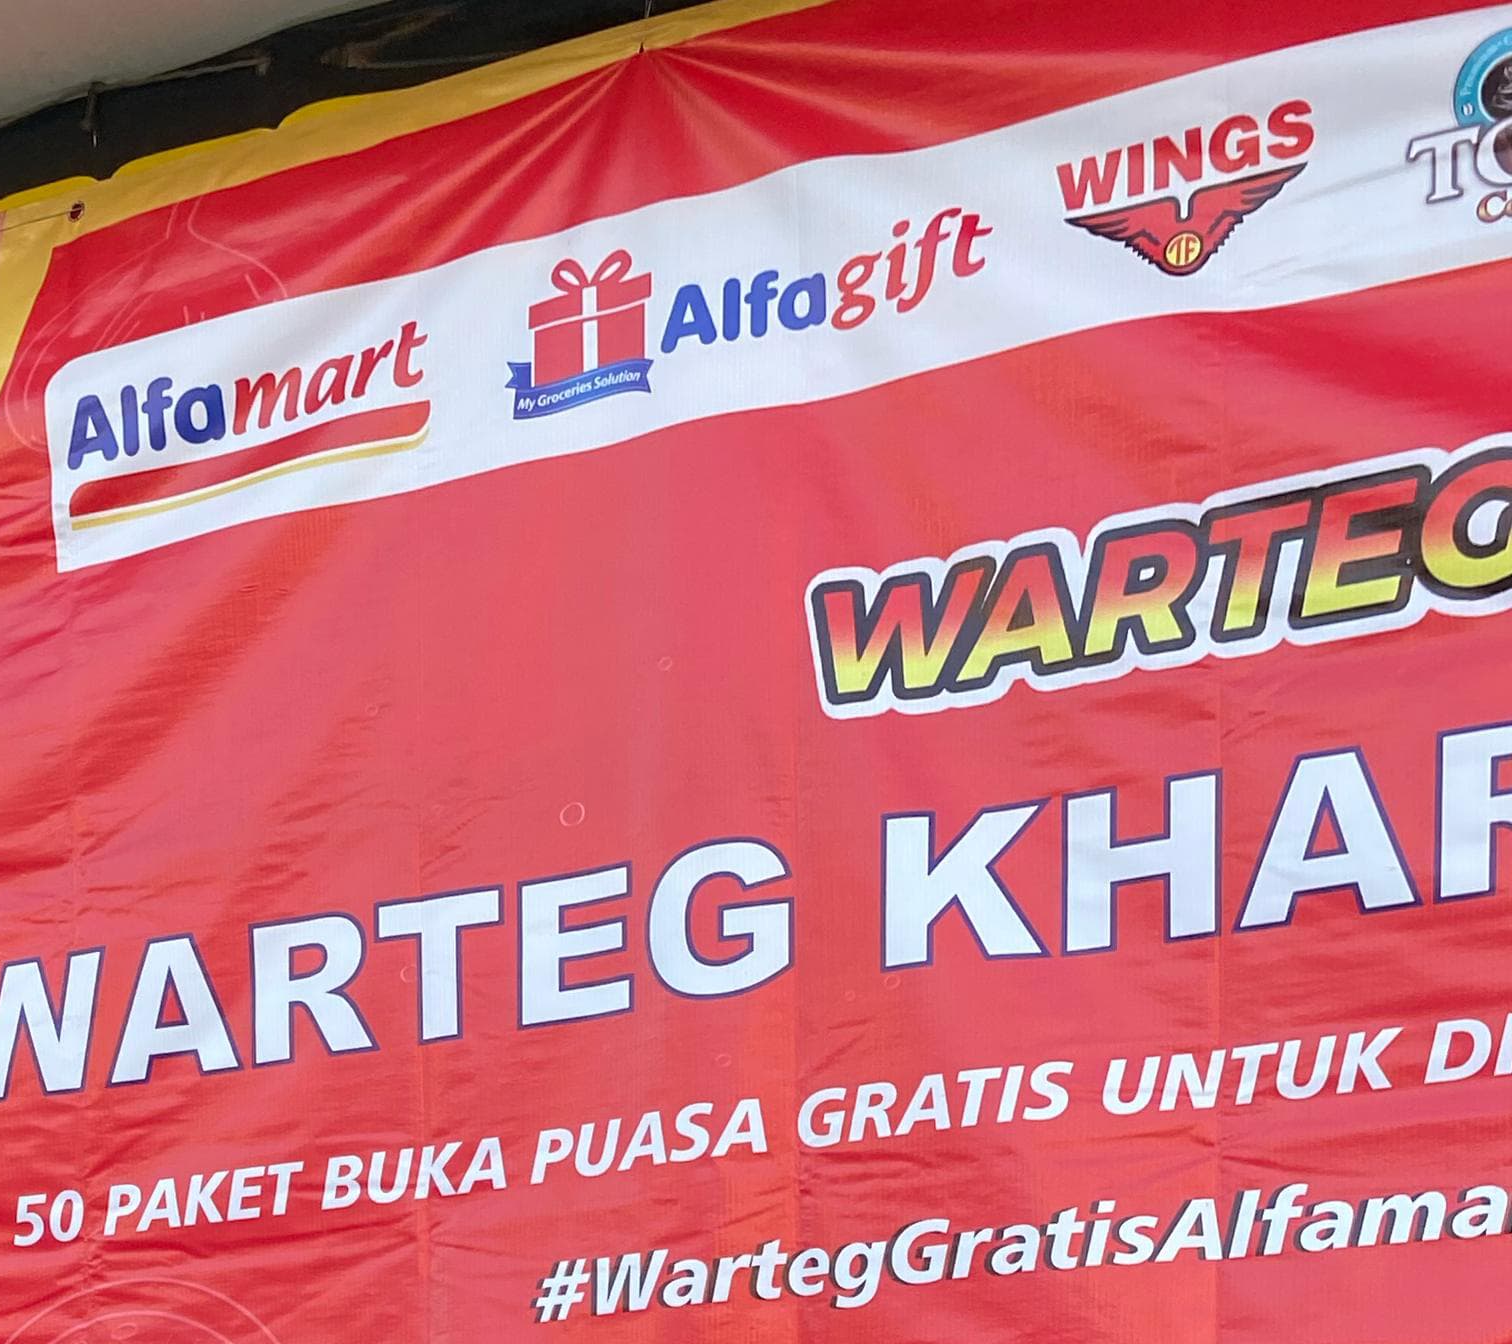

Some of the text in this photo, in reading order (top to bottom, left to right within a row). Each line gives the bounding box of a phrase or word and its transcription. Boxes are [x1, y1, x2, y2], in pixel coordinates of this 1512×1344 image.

[1056, 99, 1316, 211] WINGS
[660, 208, 993, 354] Alfagift
[66, 320, 430, 471] Alfamart
[517, 370, 641, 412] My Groceries Solution
[12, 1189, 85, 1248] 50
[102, 1161, 302, 1237] PAKET
[320, 1137, 507, 1212] BUKA
[530, 1097, 769, 1188] PUASA
[796, 1060, 1075, 1150] GRATIS
[1101, 1025, 1405, 1115] UNTUK
